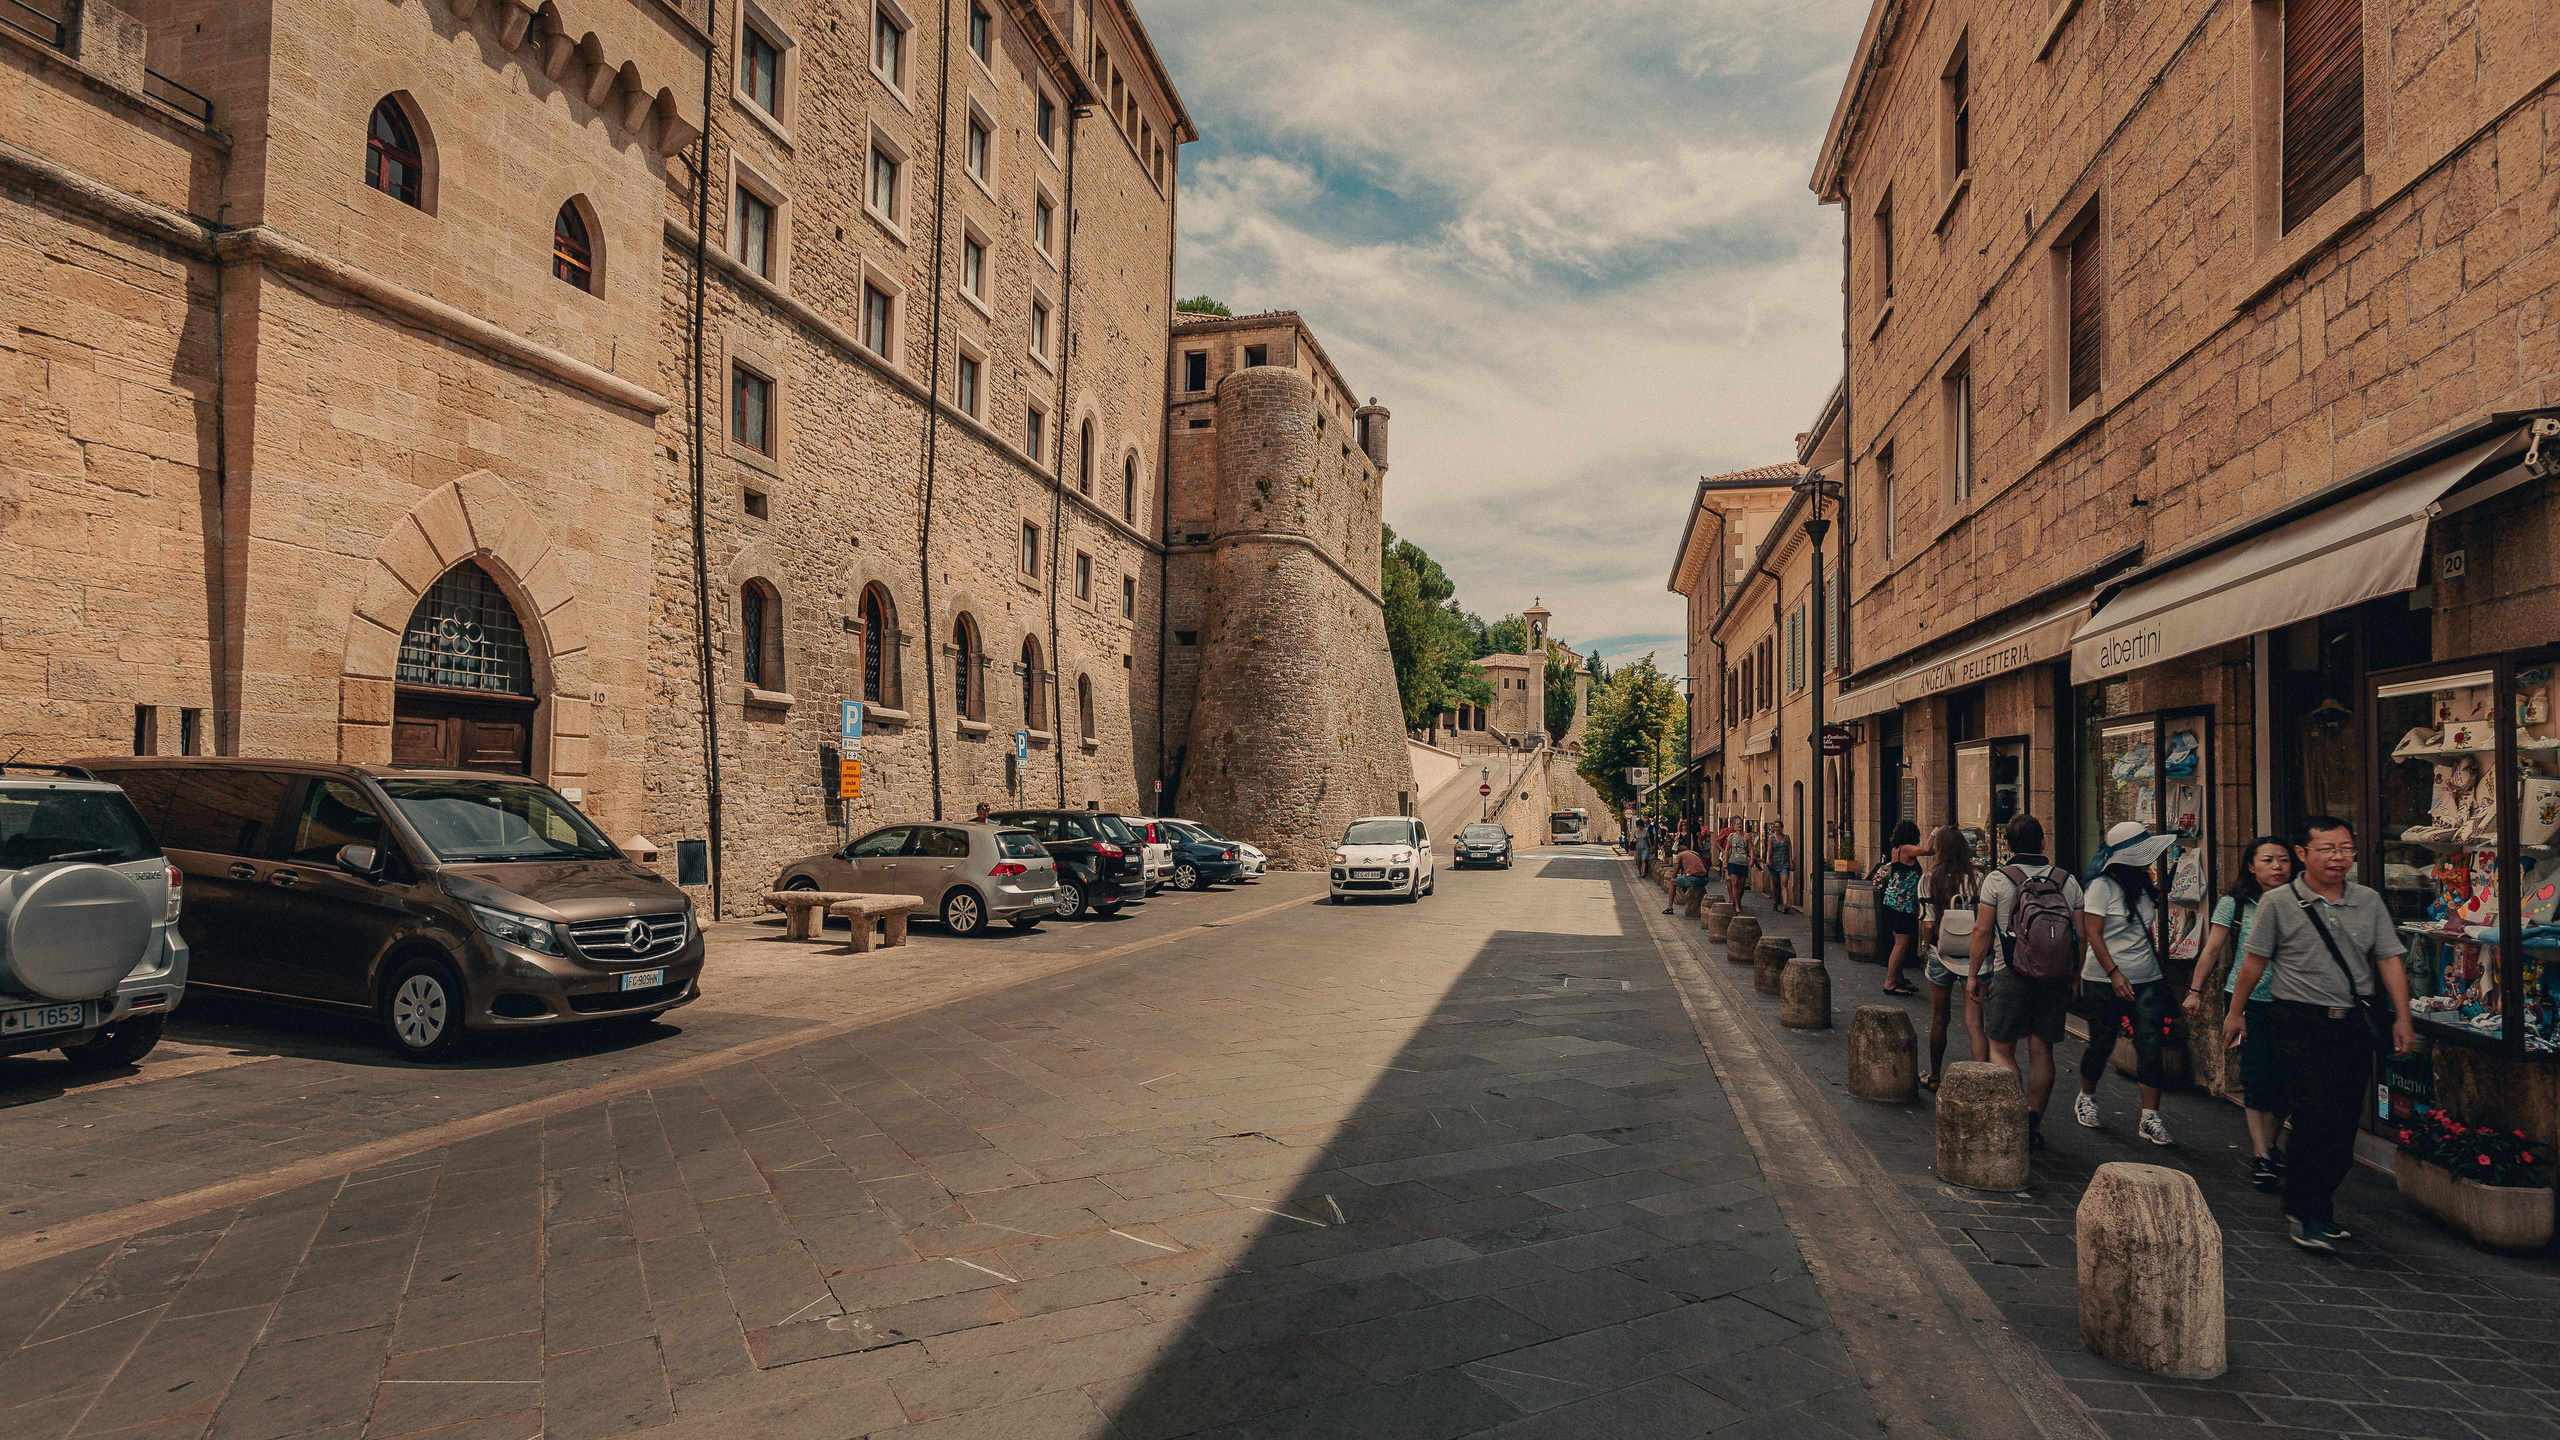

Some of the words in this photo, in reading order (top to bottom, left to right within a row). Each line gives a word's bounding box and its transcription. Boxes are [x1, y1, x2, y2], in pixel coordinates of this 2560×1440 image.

[2445, 555, 2462, 573] 20
[2100, 622, 2161, 669] albertini
[1920, 661, 1957, 694] ANGELINI
[1962, 642, 2030, 682] PELLETTERIA
[593, 691, 606, 704] 10
[845, 705, 859, 734] P
[1018, 734, 1026, 757] P
[2392, 1073, 2426, 1095] ragno
